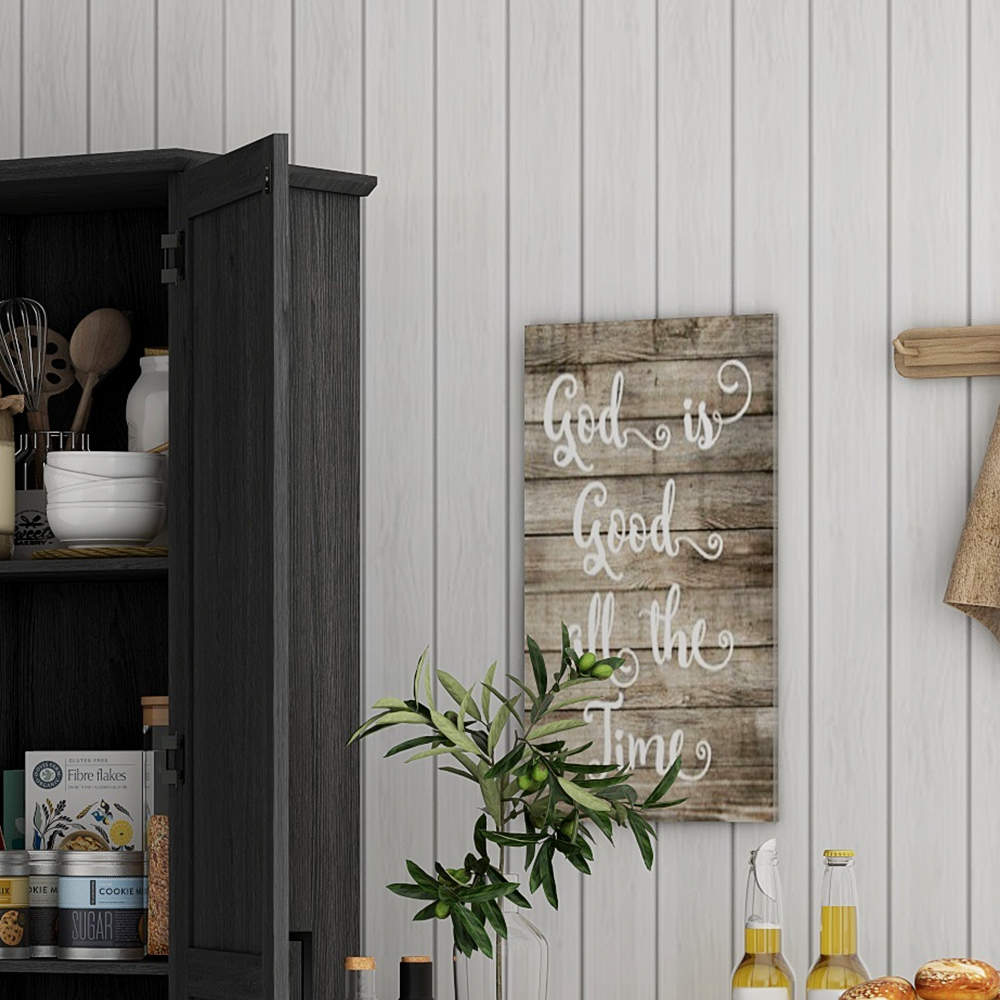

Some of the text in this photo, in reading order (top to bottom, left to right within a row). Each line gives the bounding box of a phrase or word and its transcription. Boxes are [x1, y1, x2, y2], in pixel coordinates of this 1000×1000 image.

[544, 360, 752, 472] God is
[573, 478, 723, 581] Good
[638, 582, 734, 672] the
[68, 768, 127, 781] Fibre flakes
[583, 692, 712, 781] Time
[71, 911, 113, 940] SUGAR
[99, 887, 134, 895] COOKIE
